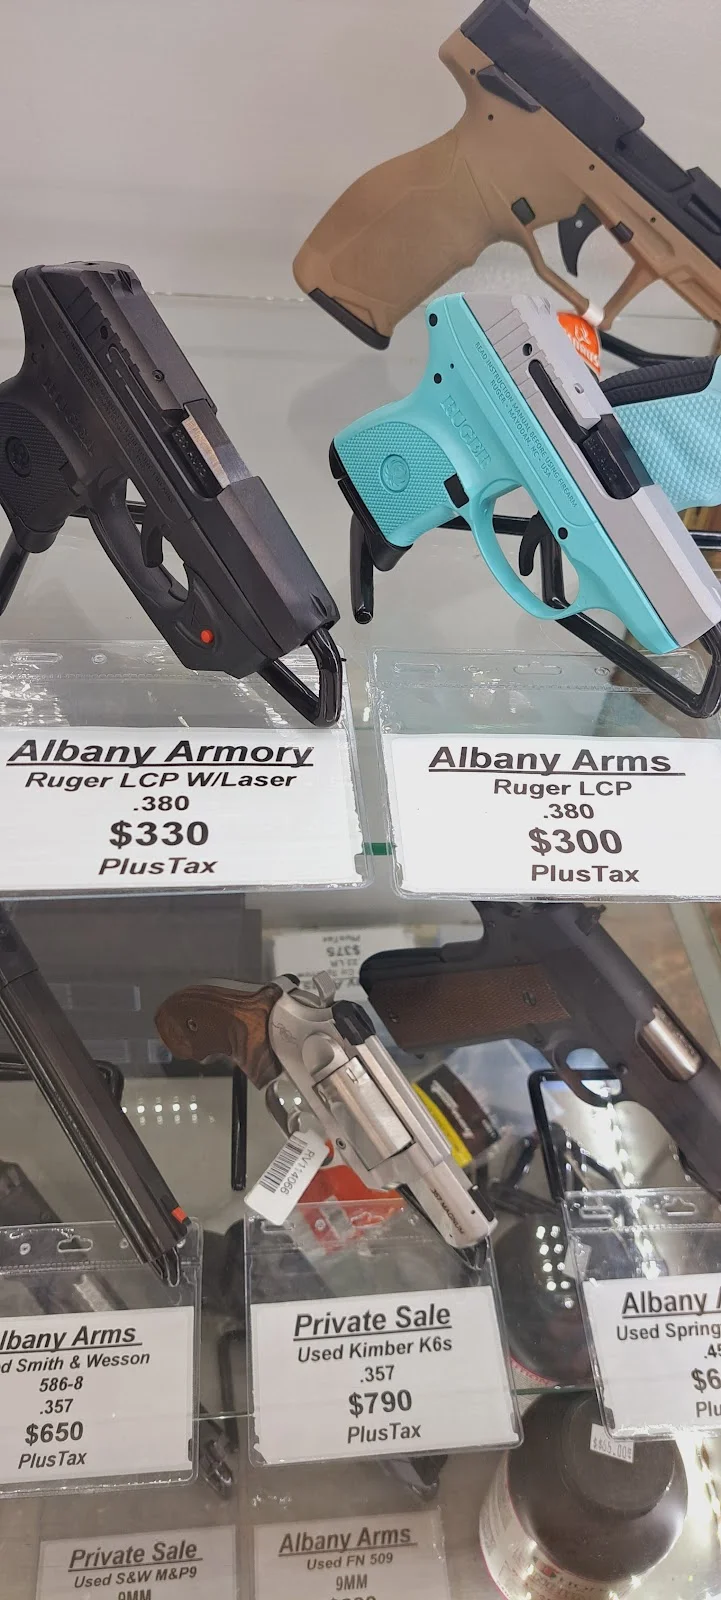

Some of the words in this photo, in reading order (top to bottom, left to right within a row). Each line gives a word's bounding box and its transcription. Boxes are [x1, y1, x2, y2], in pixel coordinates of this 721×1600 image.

[439, 394, 492, 471] RUGER
[485, 356, 515, 403] INSTRUCTION
[512, 400, 532, 433] MANUAL
[529, 429, 547, 458] BEFORE
[544, 455, 560, 480] USING
[558, 475, 578, 508] FIREARM
[489, 378, 507, 404] RUGER
[540, 462, 553, 478] USA
[7, 738, 156, 768] Albany
[164, 739, 313, 768] Armory
[429, 746, 561, 776] Albany
[572, 749, 672, 772] Arms
[25, 772, 113, 792] Ruger
[119, 772, 179, 788] LCP
[187, 772, 298, 789] W/Laser
[493, 778, 572, 799] Ruger
[579, 780, 632, 796] LCP
[133, 795, 190, 812] .380
[543, 802, 595, 819] .380
[109, 820, 210, 849] $330
[528, 827, 623, 857] $300
[98, 857, 218, 876] PlusTax
[531, 864, 640, 883] PlusTax
[441, 1201, 465, 1235] MAGNUM
[622, 1290, 708, 1317] Albany
[293, 1311, 387, 1338] Private
[395, 1303, 451, 1329] Sale
[616, 1324, 660, 1341] Used
[0, 1329, 68, 1354] lbany
[71, 1325, 137, 1346] Arms
[297, 1345, 344, 1363] Used
[349, 1339, 415, 1359] Kimber
[419, 1336, 453, 1353] K6s
[16, 1355, 65, 1373] Smith
[69, 1355, 81, 1369] &
[87, 1352, 151, 1368] Wesson
[360, 1365, 396, 1383] .357
[38, 1375, 84, 1392] 586-8
[691, 1367, 721, 1394] $6
[39, 1398, 74, 1415] .357
[348, 1389, 413, 1418] $790
[695, 1400, 721, 1418] Plu
[25, 1421, 84, 1446] $650
[347, 1422, 422, 1444] PlusTax
[18, 1450, 88, 1469] PlusTax
[278, 1533, 351, 1554] Albany
[355, 1527, 411, 1547] Arms
[69, 1545, 145, 1569] Private
[151, 1540, 197, 1562] Sale
[307, 1557, 342, 1570] Used
[346, 1555, 366, 1567] FN
[370, 1552, 393, 1565] 509
[74, 1573, 112, 1588] Used
[115, 1569, 153, 1585] S&W
[155, 1565, 198, 1582] M&P9
[335, 1573, 368, 1592] 9MM
